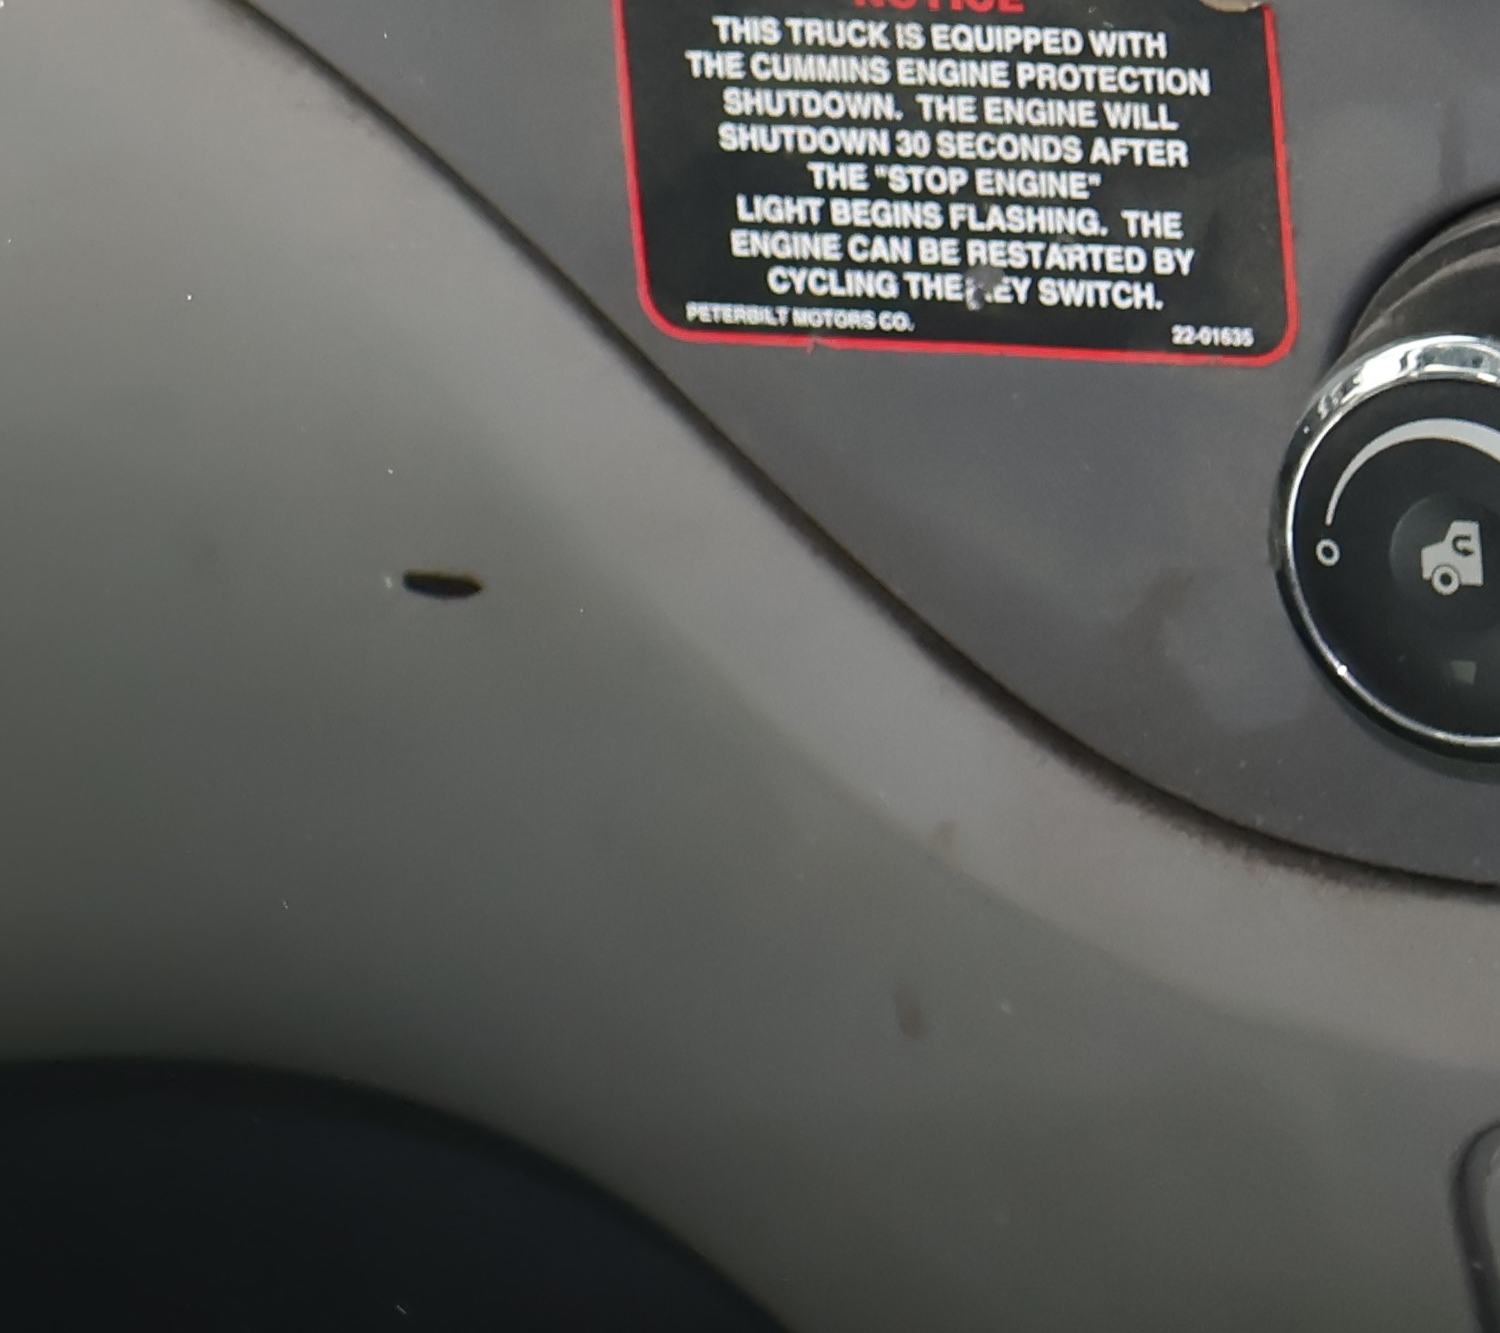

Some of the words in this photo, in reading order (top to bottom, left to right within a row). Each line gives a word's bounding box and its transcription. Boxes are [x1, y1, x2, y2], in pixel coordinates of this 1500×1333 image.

[712, 16, 782, 47] THIS
[786, 17, 890, 49] TRUCK
[896, 23, 925, 51] IS
[931, 23, 1080, 56] EQUIPPED
[1087, 29, 1167, 58] WITH
[685, 50, 746, 80] THE
[750, 53, 891, 85] CUMMINS
[898, 58, 1011, 89] ENGINE
[1016, 62, 1210, 96] PROTECTION
[722, 88, 904, 122] SHUTDOWN.
[917, 94, 978, 124] THE
[985, 96, 1098, 128] ENGINE
[1104, 100, 1178, 130] WILL
[718, 125, 889, 157] SHUTDOWN
[895, 134, 931, 159] 30
[936, 133, 1083, 164] SECONDS
[1090, 138, 1188, 167] AFTER
[808, 162, 868, 191] THE
[874, 165, 968, 195] "STOP
[975, 168, 1101, 200] ENGINE"
[737, 195, 824, 226] LIGHT
[830, 197, 943, 230] BEGINS
[949, 202, 1108, 237] FLASHING.
[1121, 209, 1183, 239] THE
[730, 229, 843, 262] ENGINE
[847, 234, 912, 264] CAN
[918, 237, 960, 265] BE
[967, 239, 1148, 273] RESTARTED
[1155, 245, 1195, 276] BY
[767, 266, 898, 299] CYCLING
[904, 271, 967, 301] THE
[1039, 277, 1164, 310] SWITCH.
[687, 302, 787, 327] PETERBILT
[792, 307, 874, 330] MOTORS
[878, 312, 914, 332] CO.
